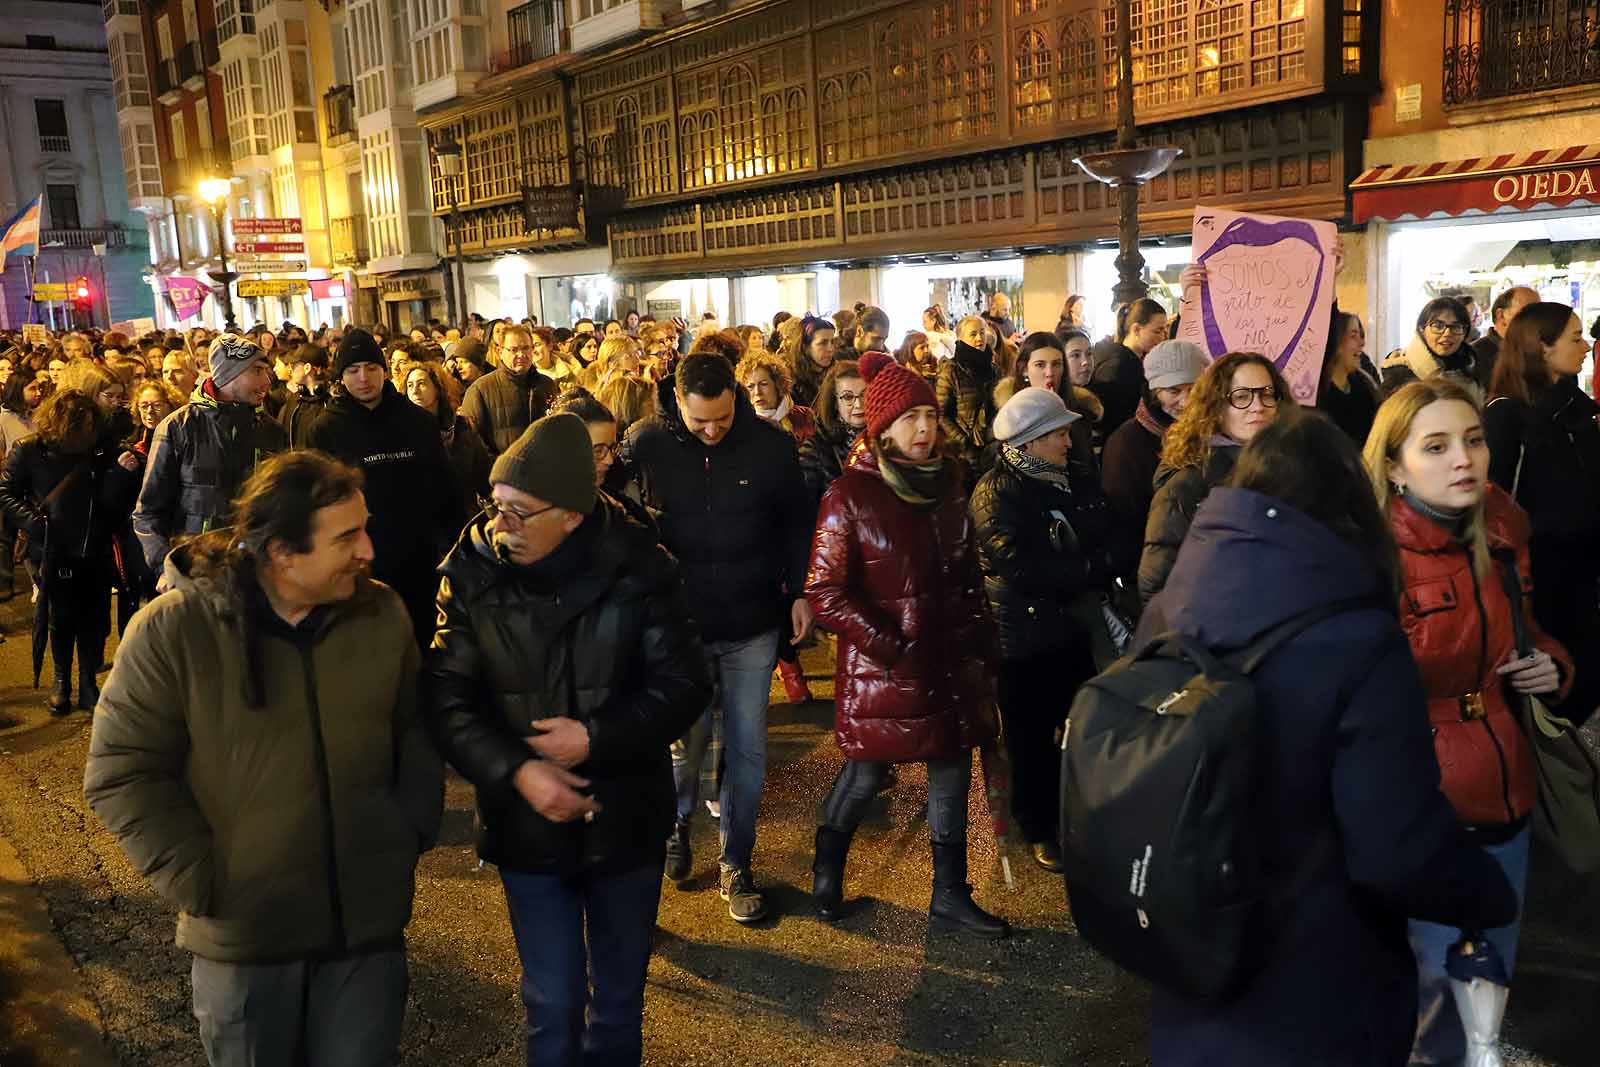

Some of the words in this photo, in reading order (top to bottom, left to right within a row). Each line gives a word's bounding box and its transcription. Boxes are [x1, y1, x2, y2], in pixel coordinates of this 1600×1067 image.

[1493, 168, 1598, 202] OJEDA
[1217, 259, 1291, 294] SOMOS
[1223, 291, 1266, 318] grito
[1271, 293, 1296, 310] de
